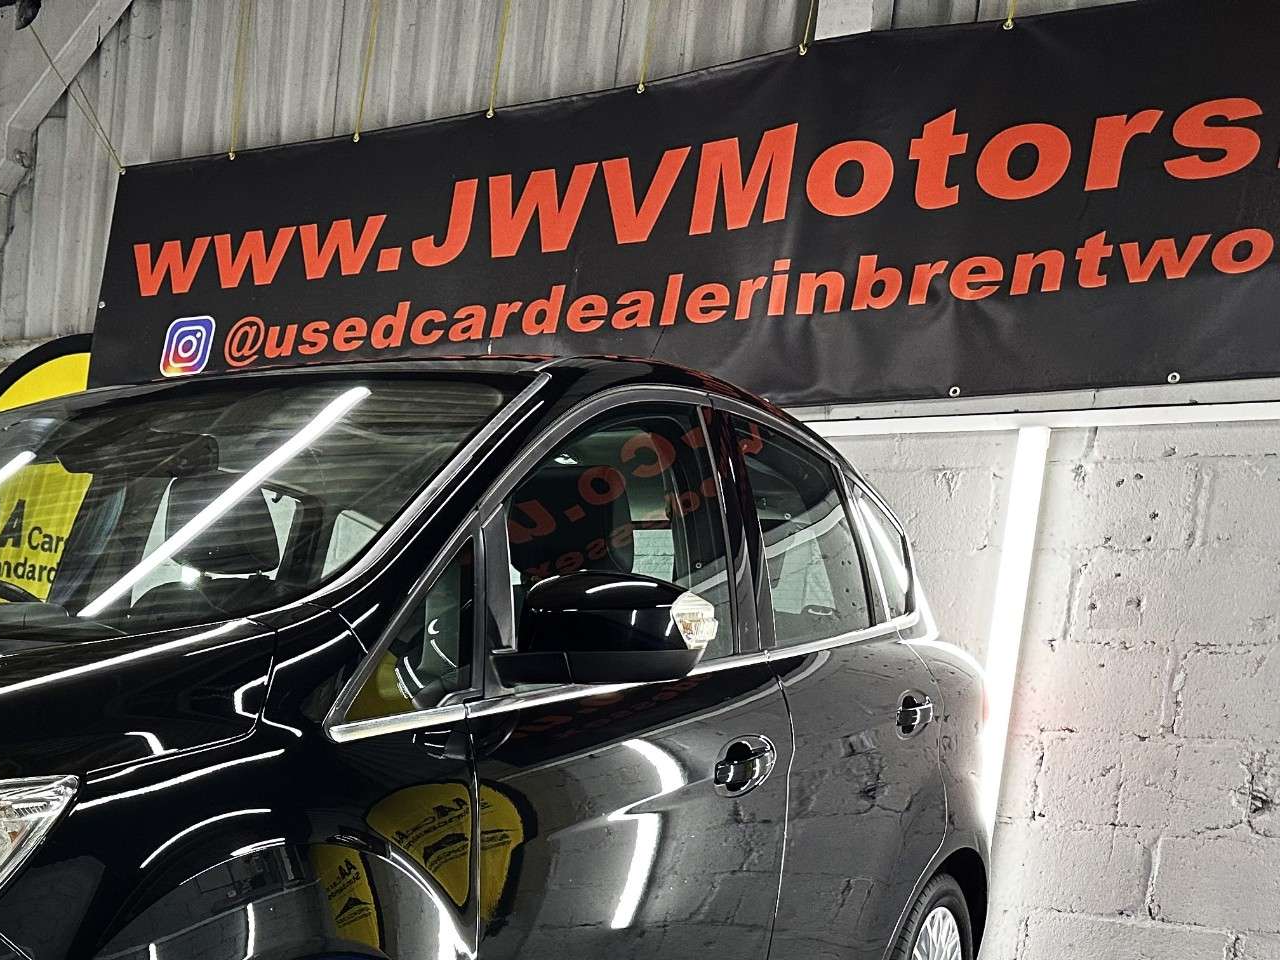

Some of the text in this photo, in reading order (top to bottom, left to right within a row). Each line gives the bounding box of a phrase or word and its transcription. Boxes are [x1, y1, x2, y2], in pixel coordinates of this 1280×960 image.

[133, 96, 1280, 297] www.JWVMotors
[223, 228, 1275, 367] @usedcardealerinbrentwo
[27, 526, 69, 554] Car
